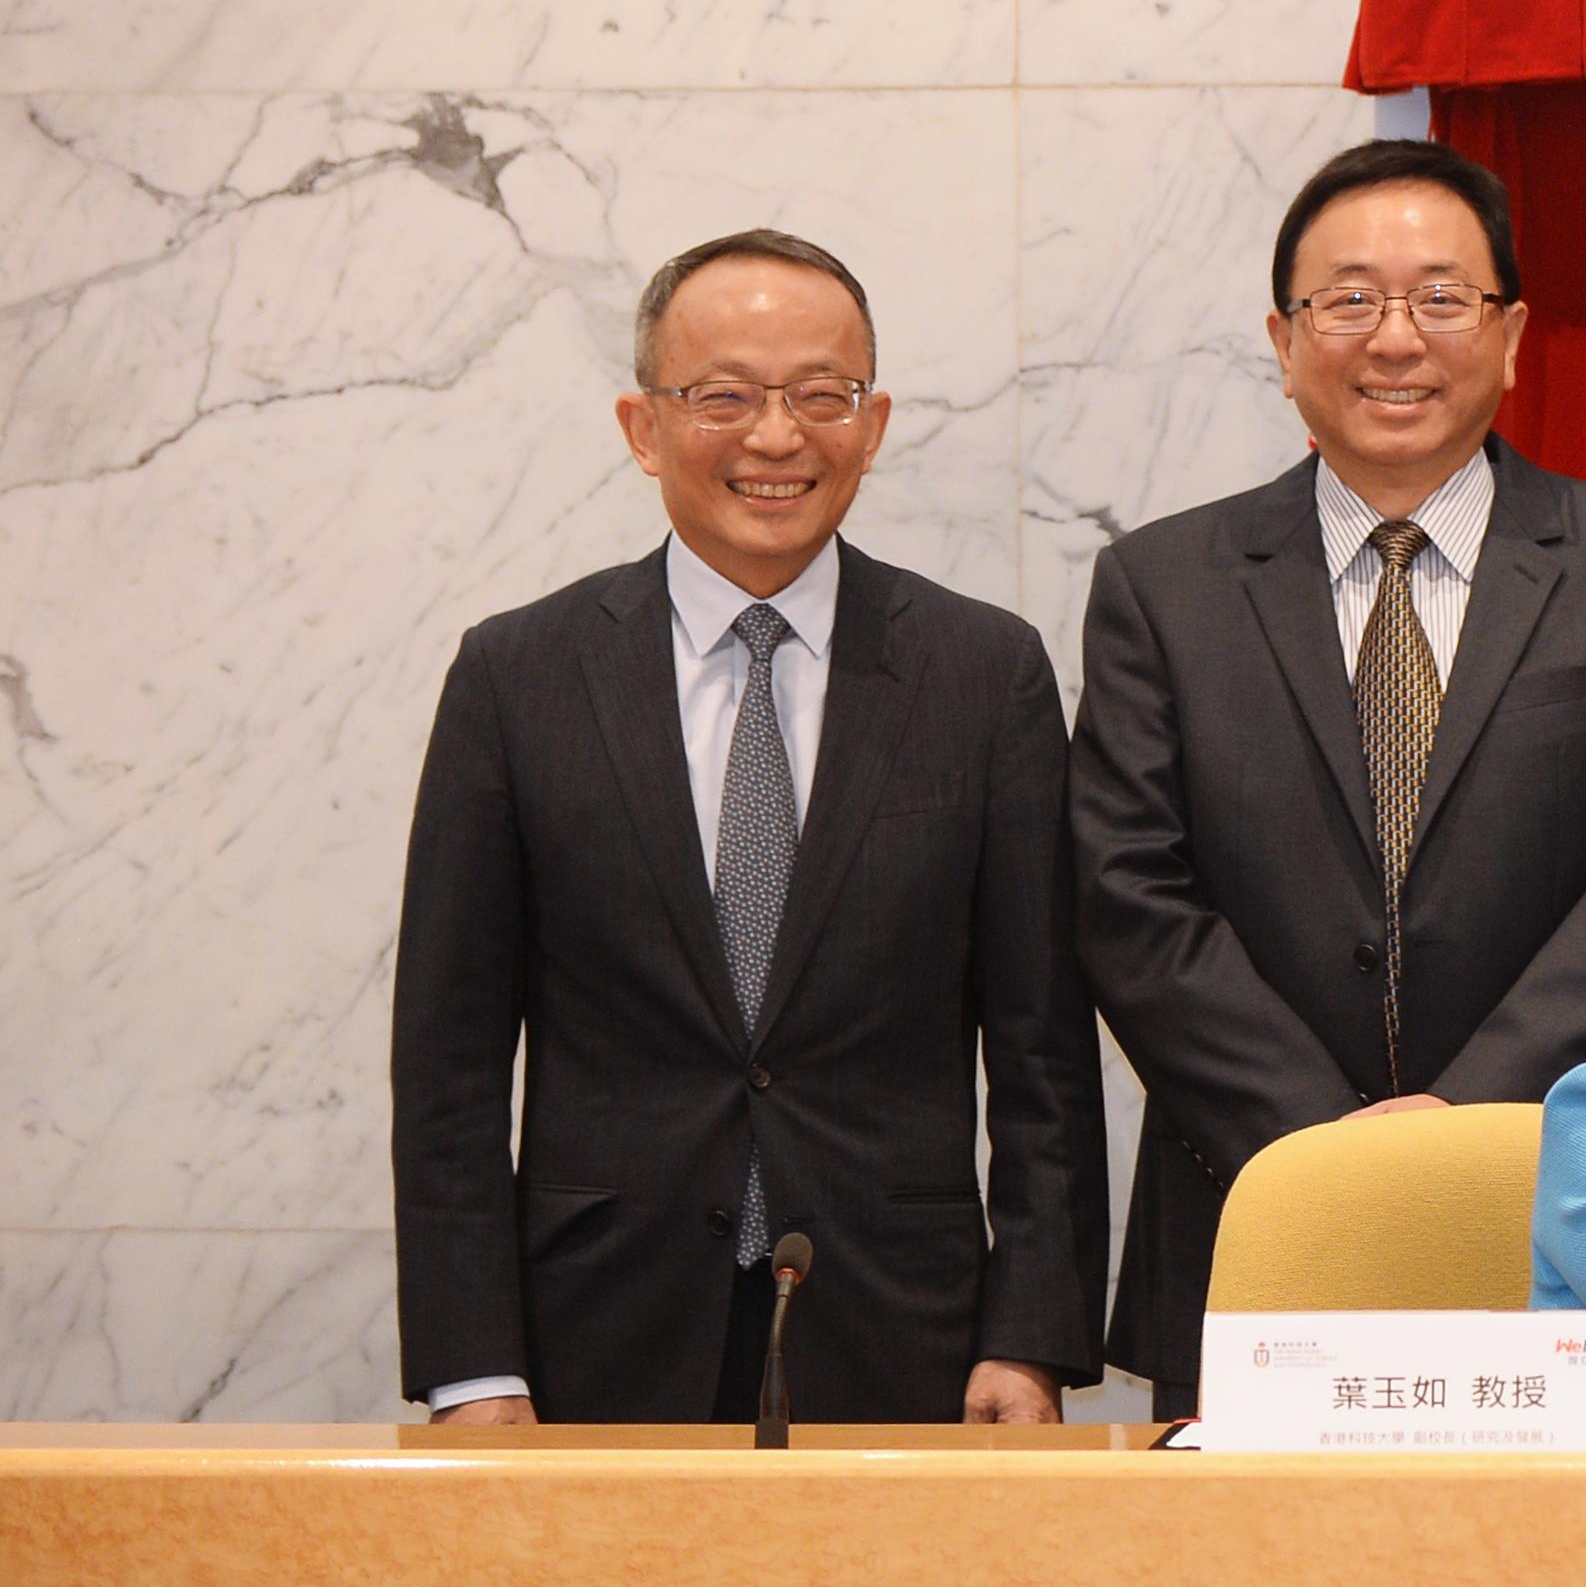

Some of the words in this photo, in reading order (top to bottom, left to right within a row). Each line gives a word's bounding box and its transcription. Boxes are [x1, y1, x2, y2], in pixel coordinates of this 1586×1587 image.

[1333, 1375, 1446, 1409] 葉玉如
[1472, 1375, 1547, 1409] 教授
